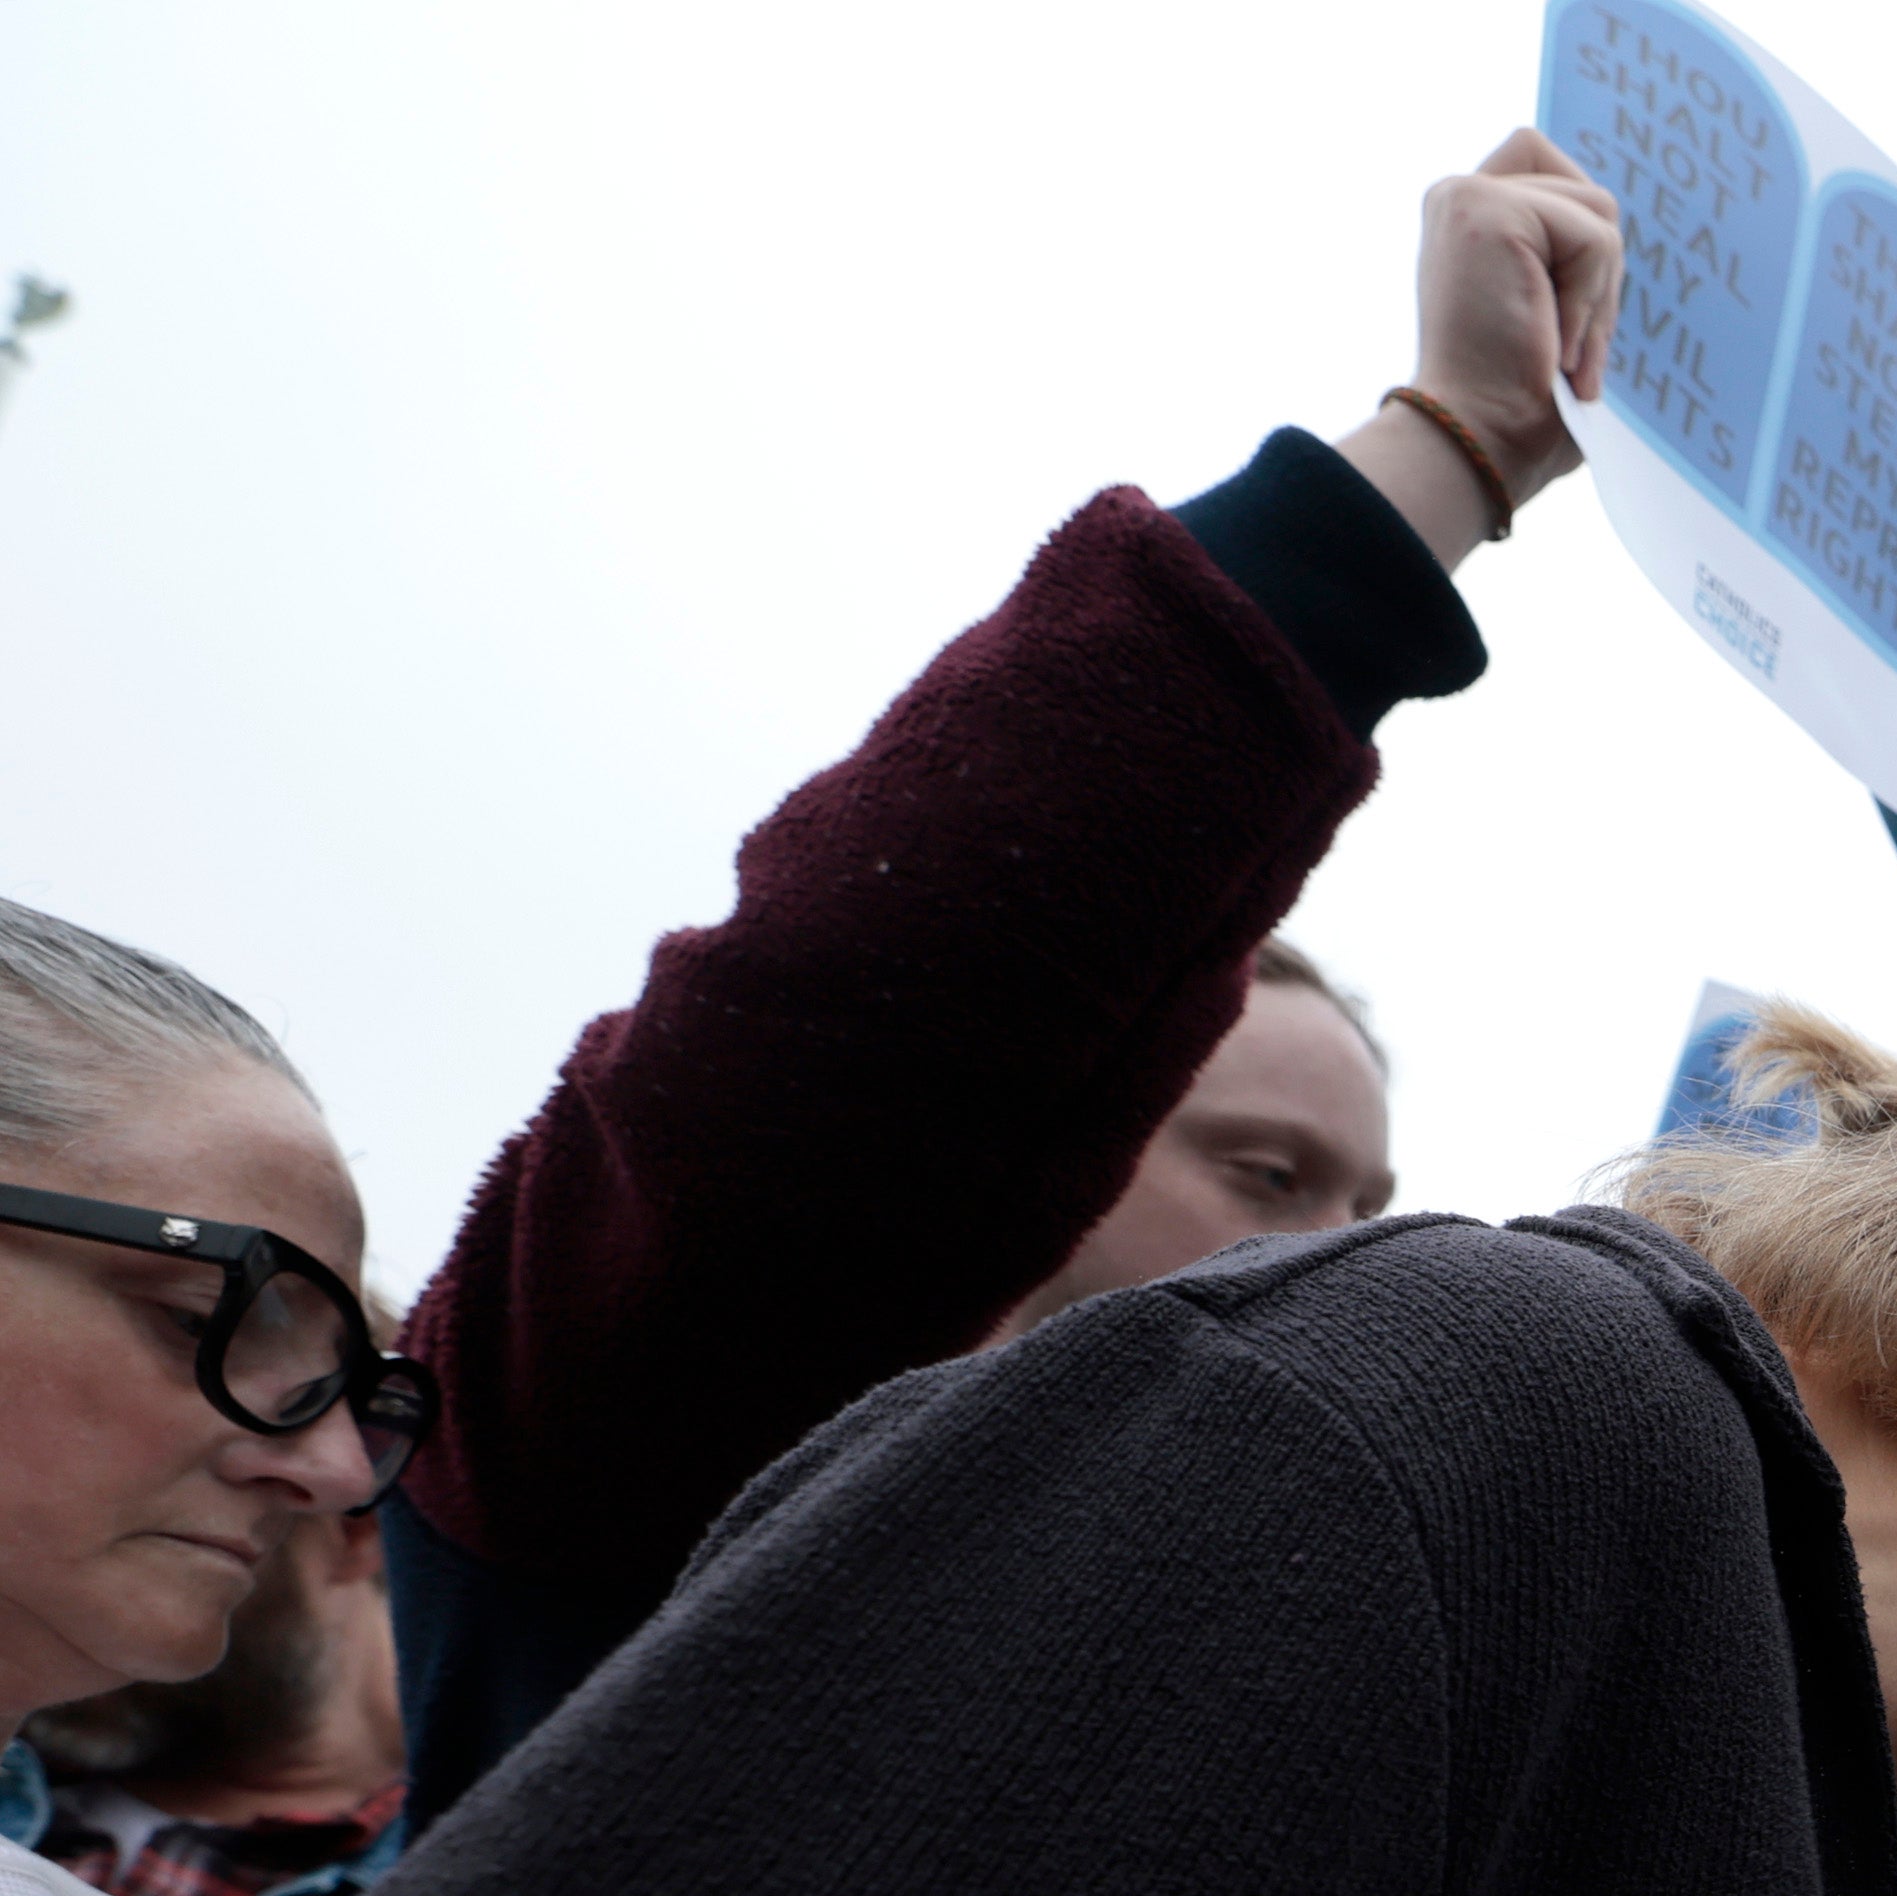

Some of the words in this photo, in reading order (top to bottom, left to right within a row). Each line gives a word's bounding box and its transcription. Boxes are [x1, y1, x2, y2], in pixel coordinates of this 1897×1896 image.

[1576, 43, 1773, 202] SHALT
[1591, 3, 1770, 150] THOU
[1575, 129, 1750, 310] STEAL
[1615, 104, 1738, 221] NOT
[1623, 213, 1703, 305] MY
[1619, 271, 1716, 398] IVIL
